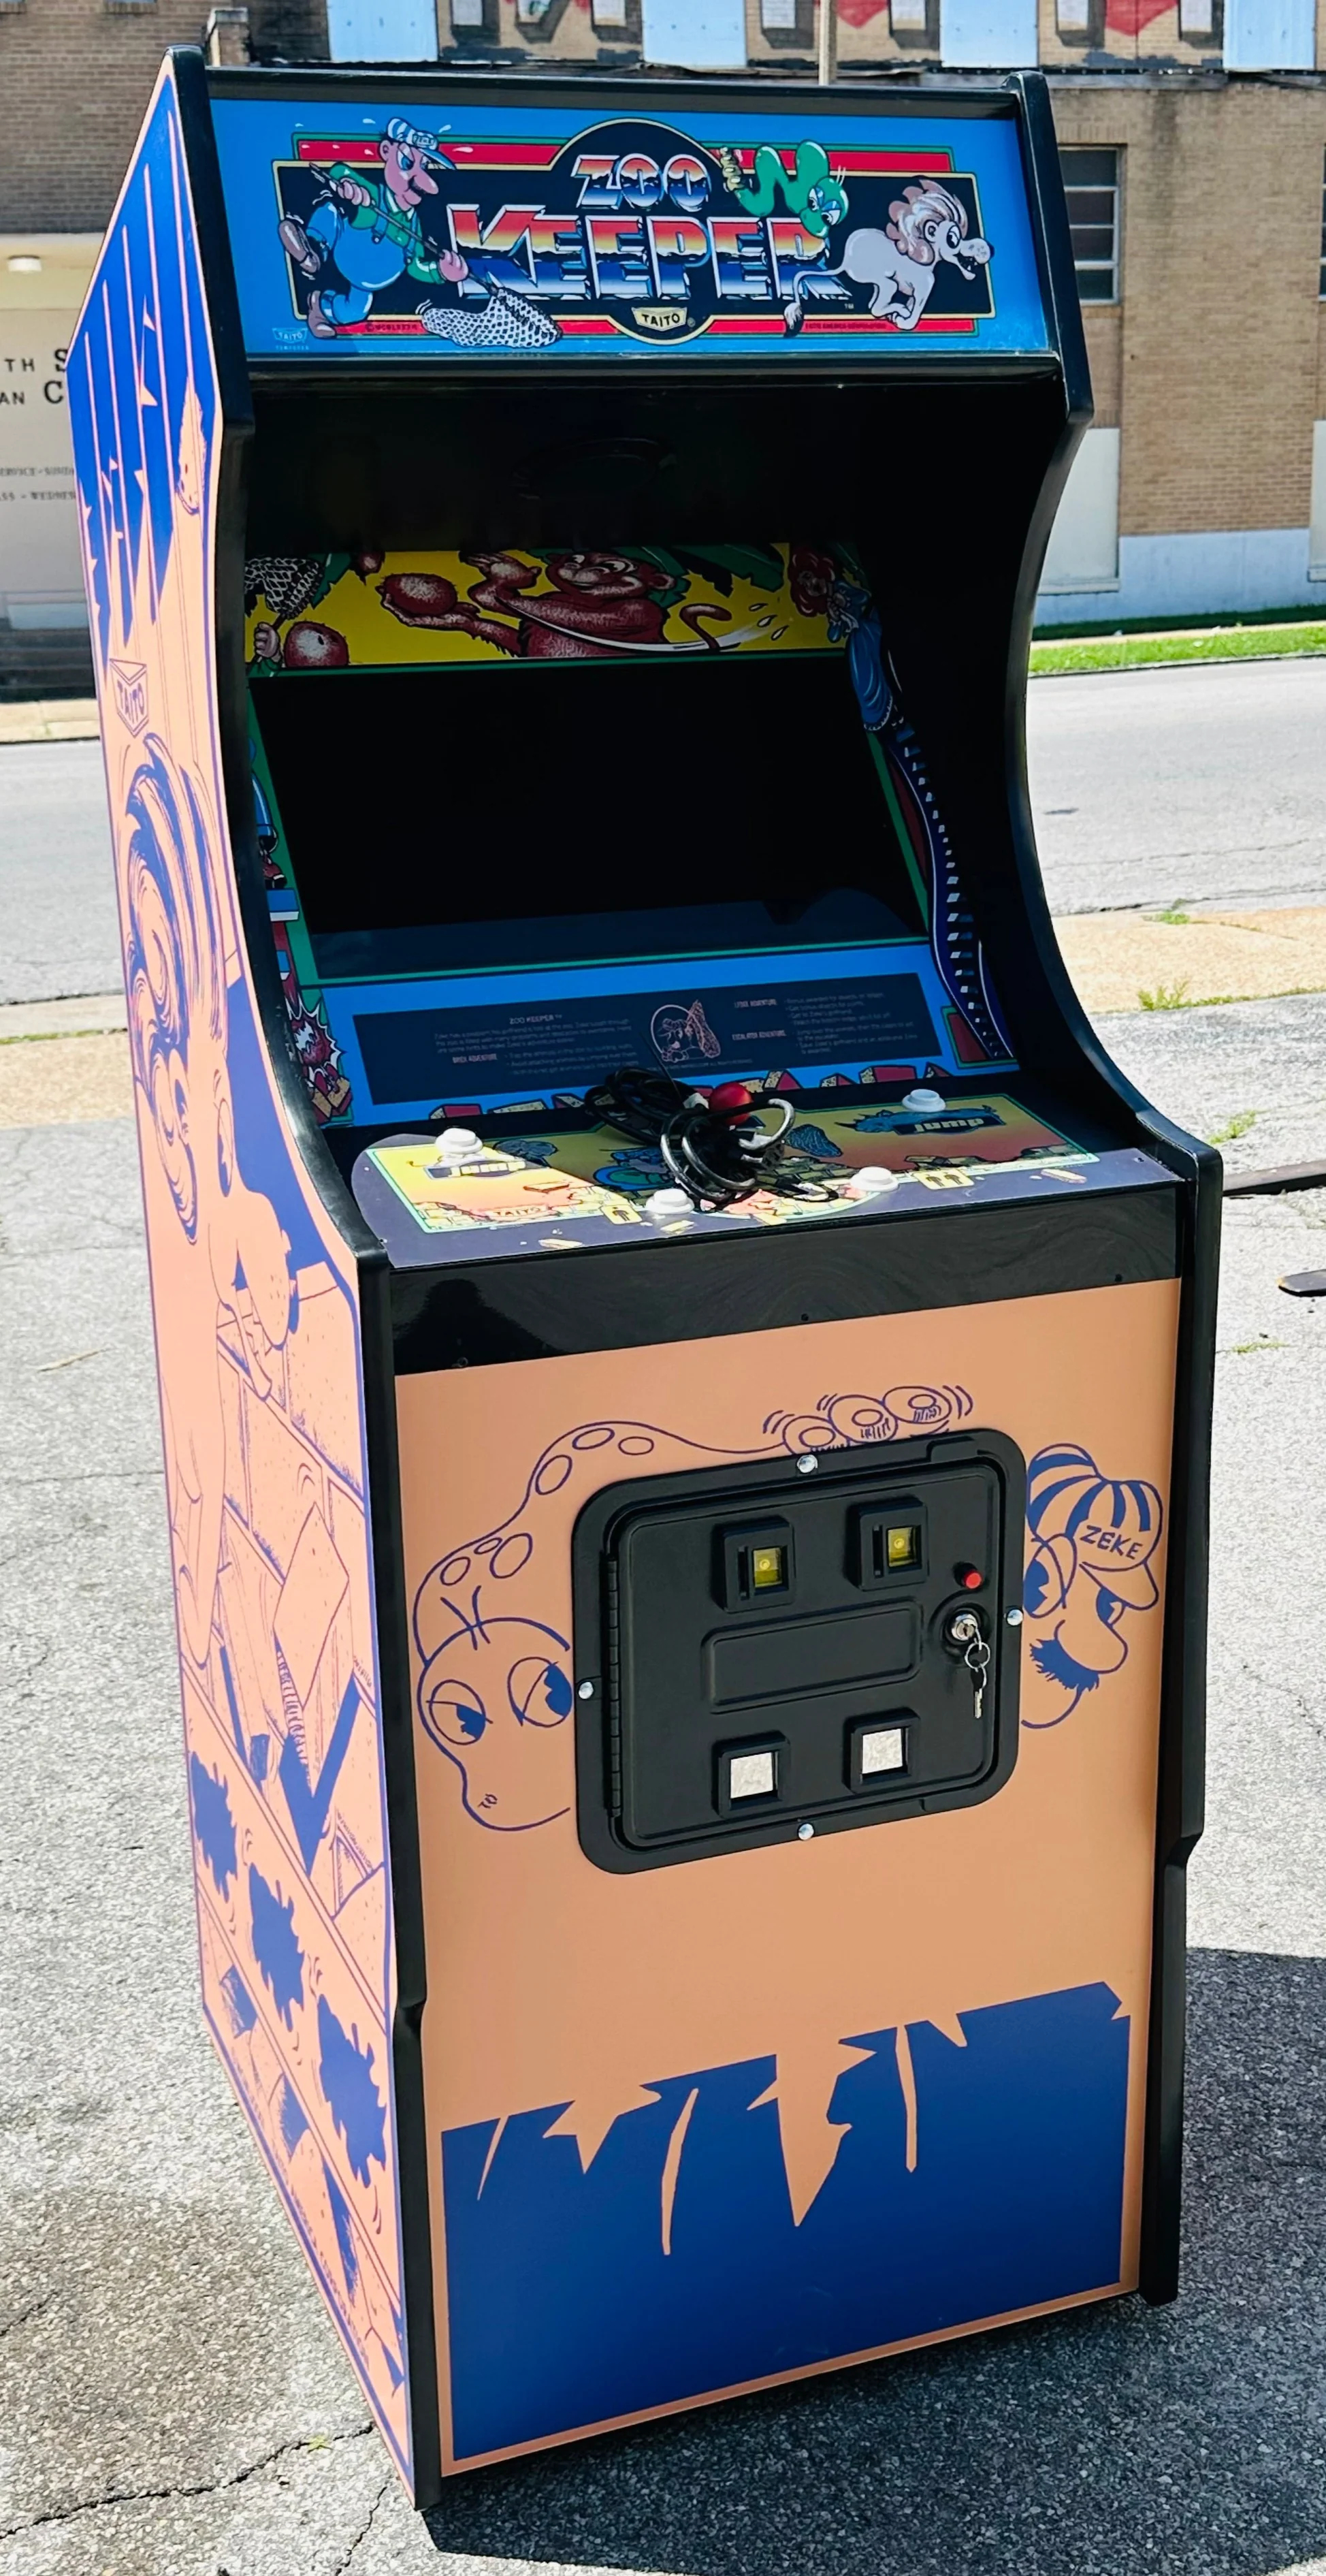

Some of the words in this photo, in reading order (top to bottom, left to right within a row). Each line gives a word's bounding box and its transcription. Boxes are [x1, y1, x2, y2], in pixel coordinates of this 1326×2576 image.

[571, 153, 711, 211] ZOO
[447, 204, 852, 300] KEEPER
[278, 332, 303, 341] TAITO
[641, 313, 680, 327] TAITO
[116, 679, 145, 725] TAITO
[1080, 1525, 1143, 1560] ZEKE
